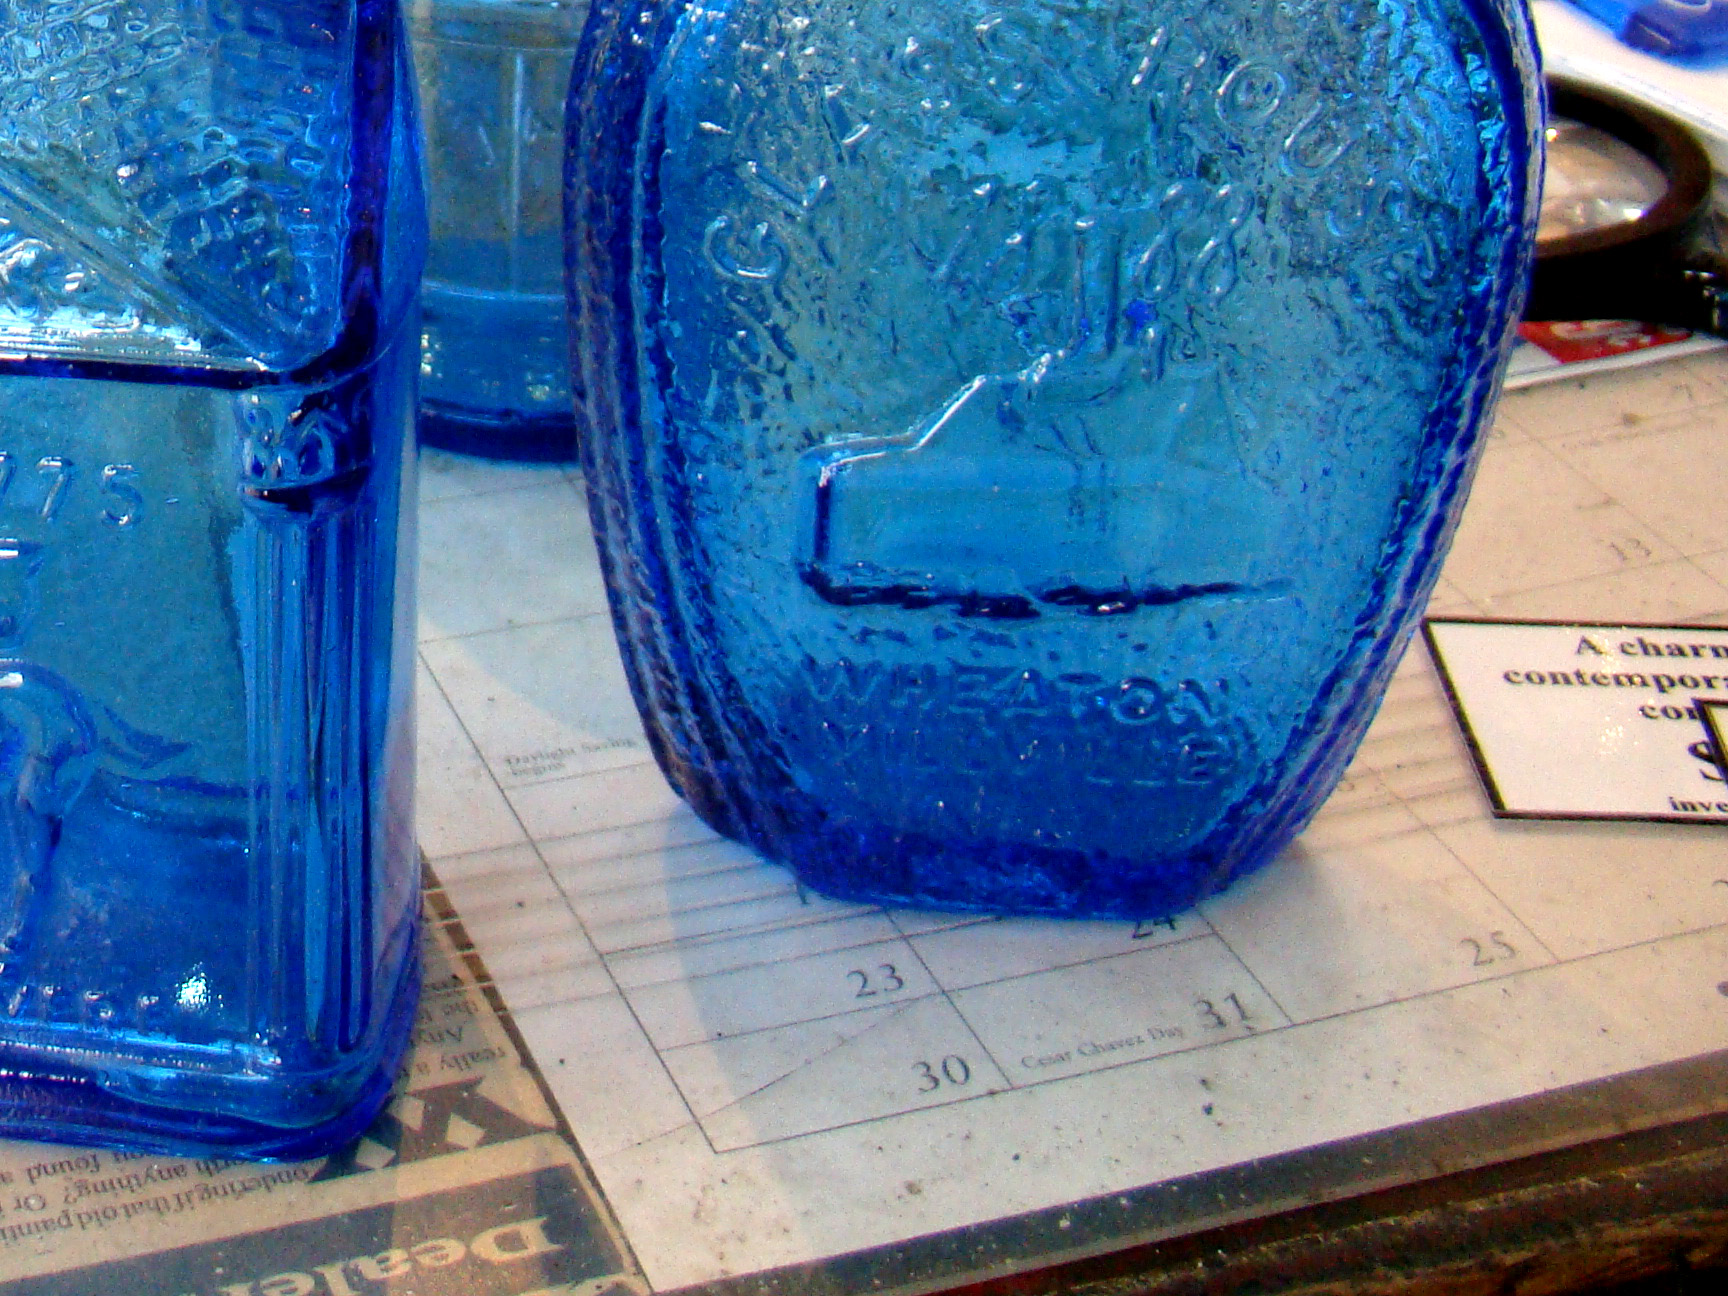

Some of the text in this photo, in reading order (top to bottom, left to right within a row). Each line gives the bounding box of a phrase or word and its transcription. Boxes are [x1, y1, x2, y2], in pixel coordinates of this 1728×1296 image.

[1575, 634, 1604, 656] A
[796, 656, 1232, 728] WHEATON
[1502, 666, 1728, 694] contempor
[846, 963, 905, 999] 23
[1194, 992, 1254, 1028] 31
[910, 1054, 971, 1093] 30
[26, 1154, 102, 1184] found
[62, 1162, 189, 1203] anything?
[13, 1192, 49, 1213] Or
[76, 1205, 120, 1231] old
